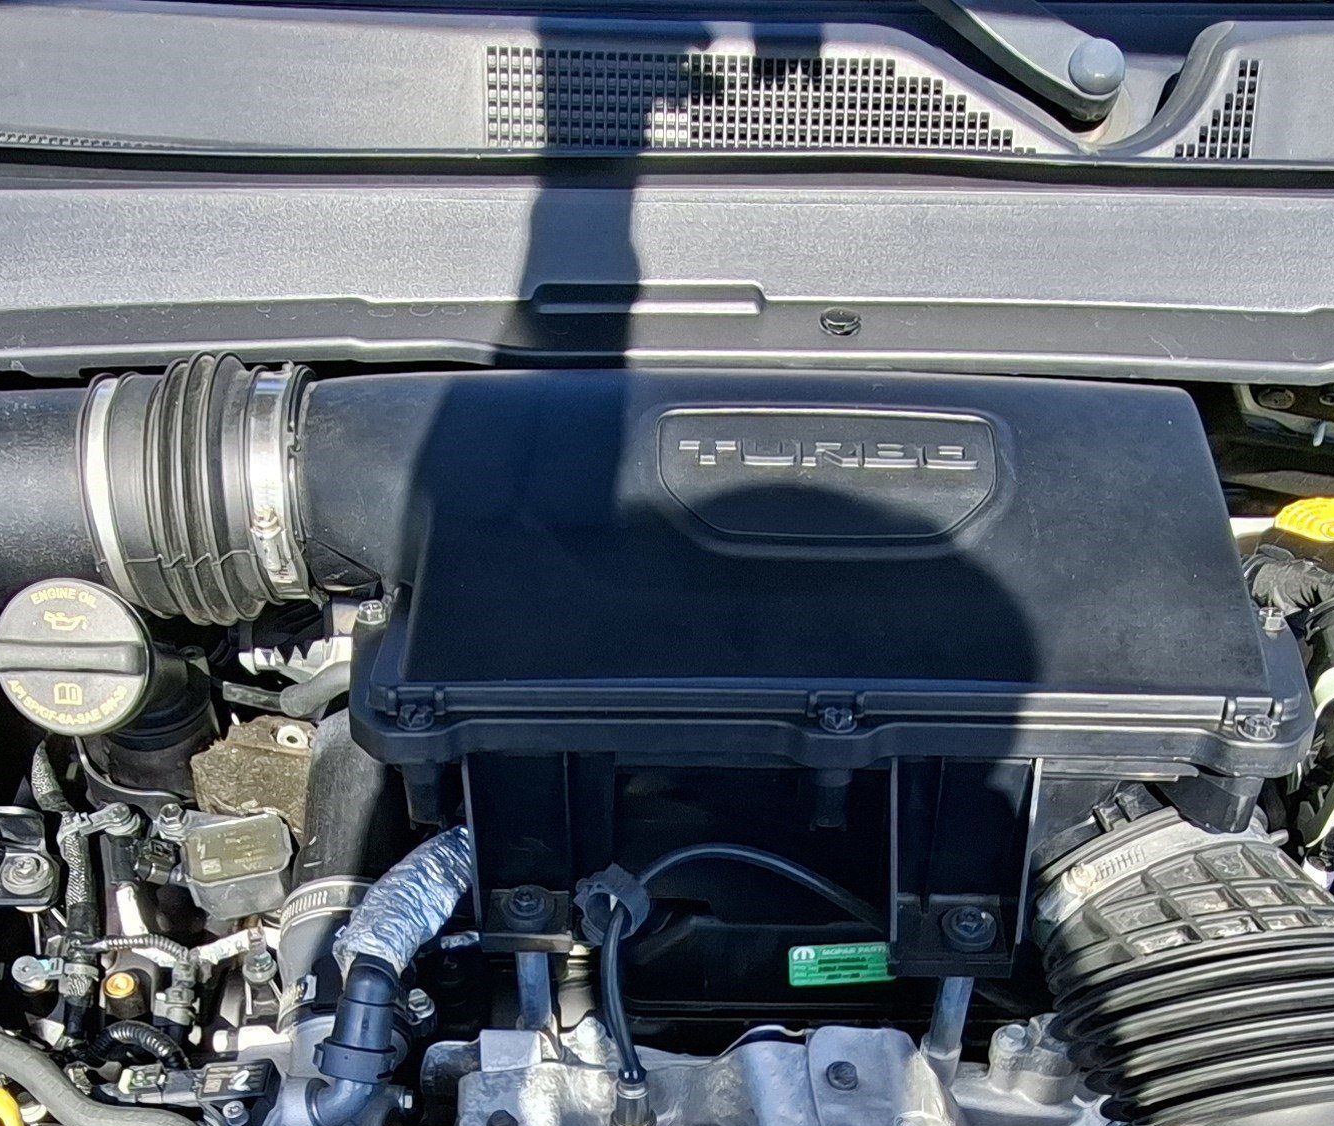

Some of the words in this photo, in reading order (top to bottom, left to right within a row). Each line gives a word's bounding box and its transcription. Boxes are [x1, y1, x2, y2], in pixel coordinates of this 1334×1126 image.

[678, 440, 979, 470] TURBO
[30, 587, 76, 605] ENGINE
[78, 590, 98, 609] OIL
[7, 679, 28, 701] API
